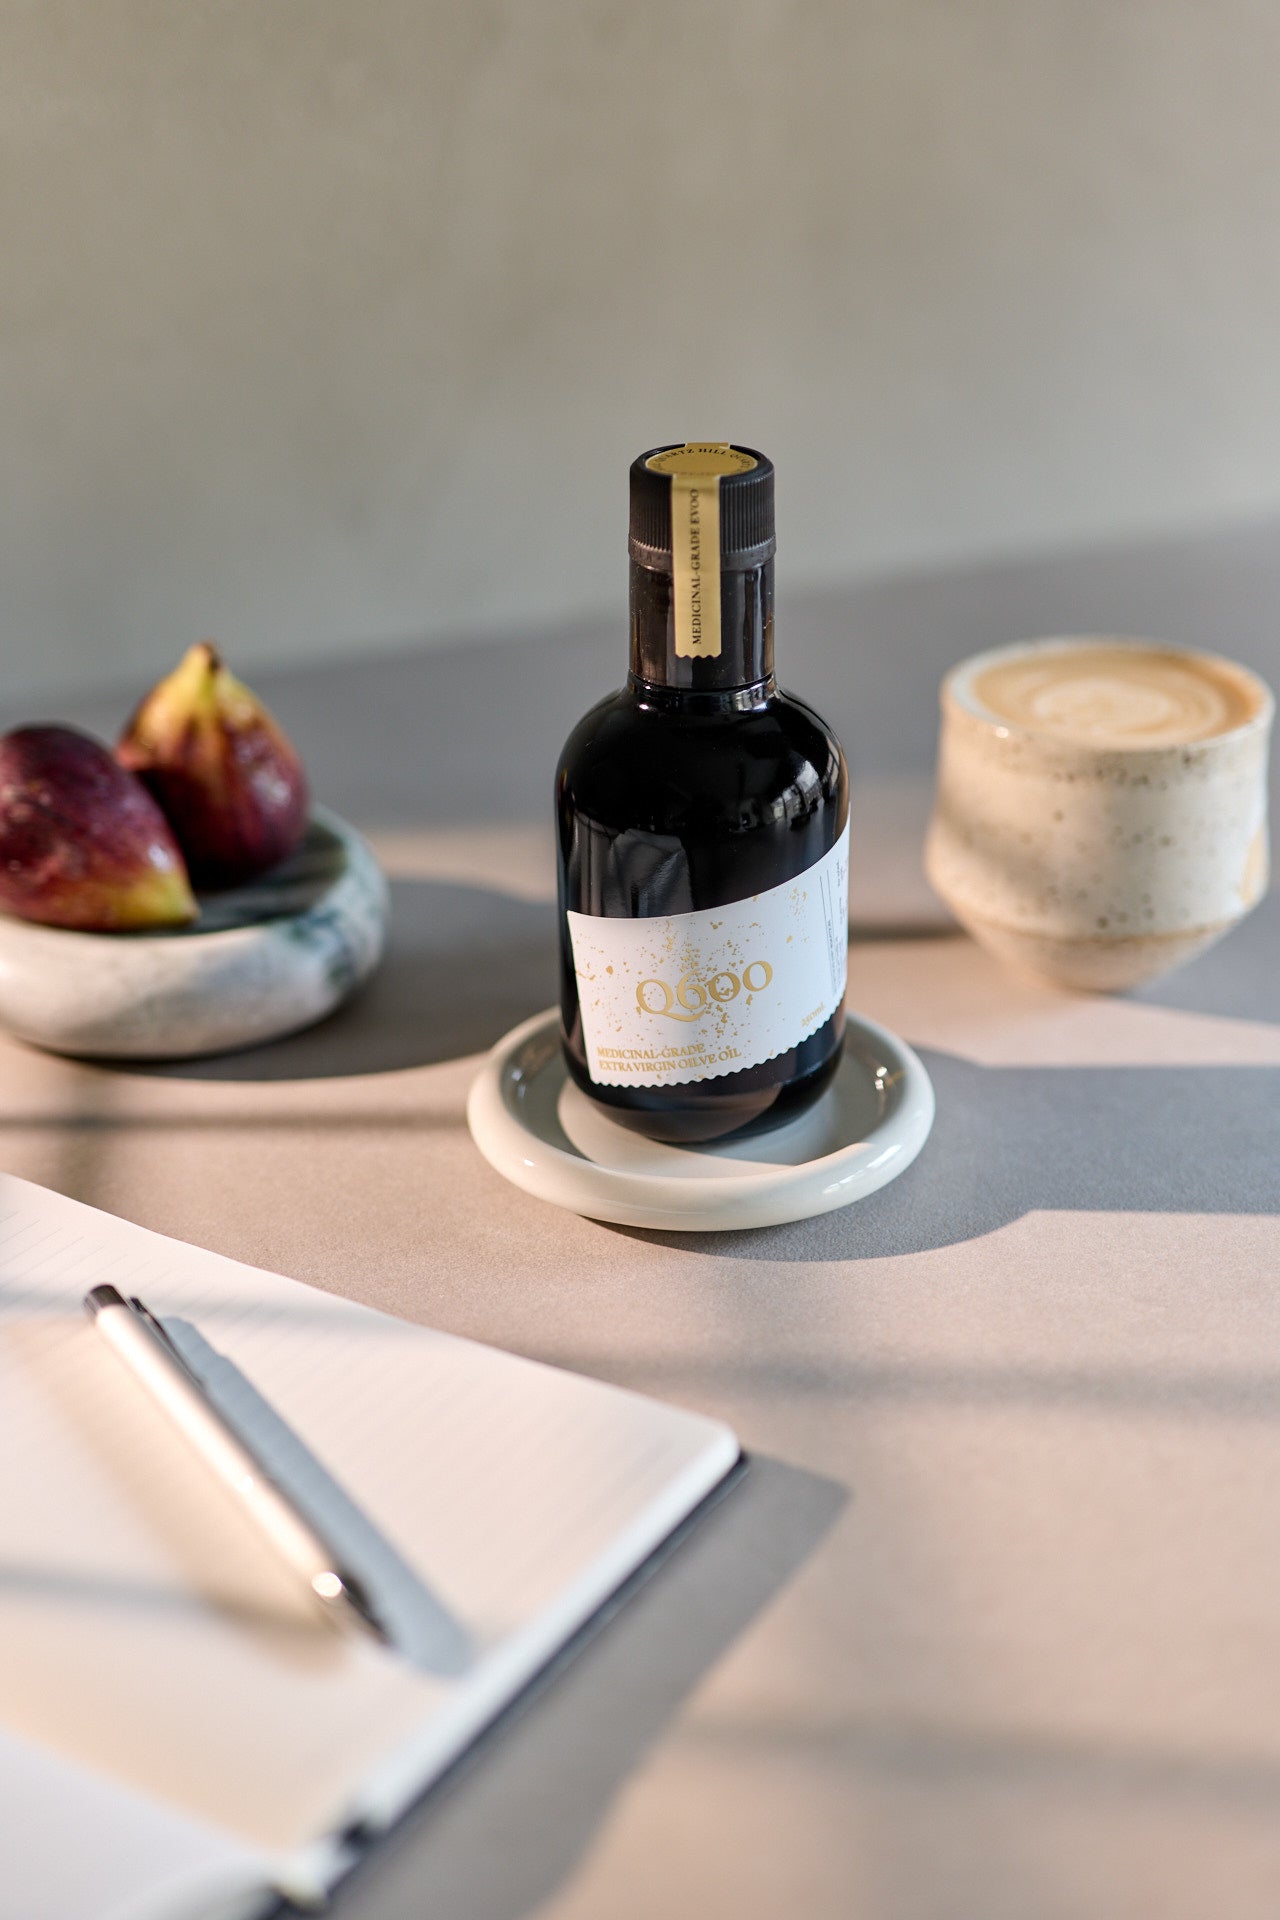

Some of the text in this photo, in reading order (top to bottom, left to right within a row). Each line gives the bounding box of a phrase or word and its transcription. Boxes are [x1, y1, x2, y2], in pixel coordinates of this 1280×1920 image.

[690, 489, 702, 644] MEDICINAL-GRADE EVOO
[597, 1044, 706, 1060] MEDICINAL-GRADE
[599, 1060, 633, 1072] EXTRA
[634, 1060, 677, 1072] VIRGIN
[719, 1049, 741, 1061] OIL
